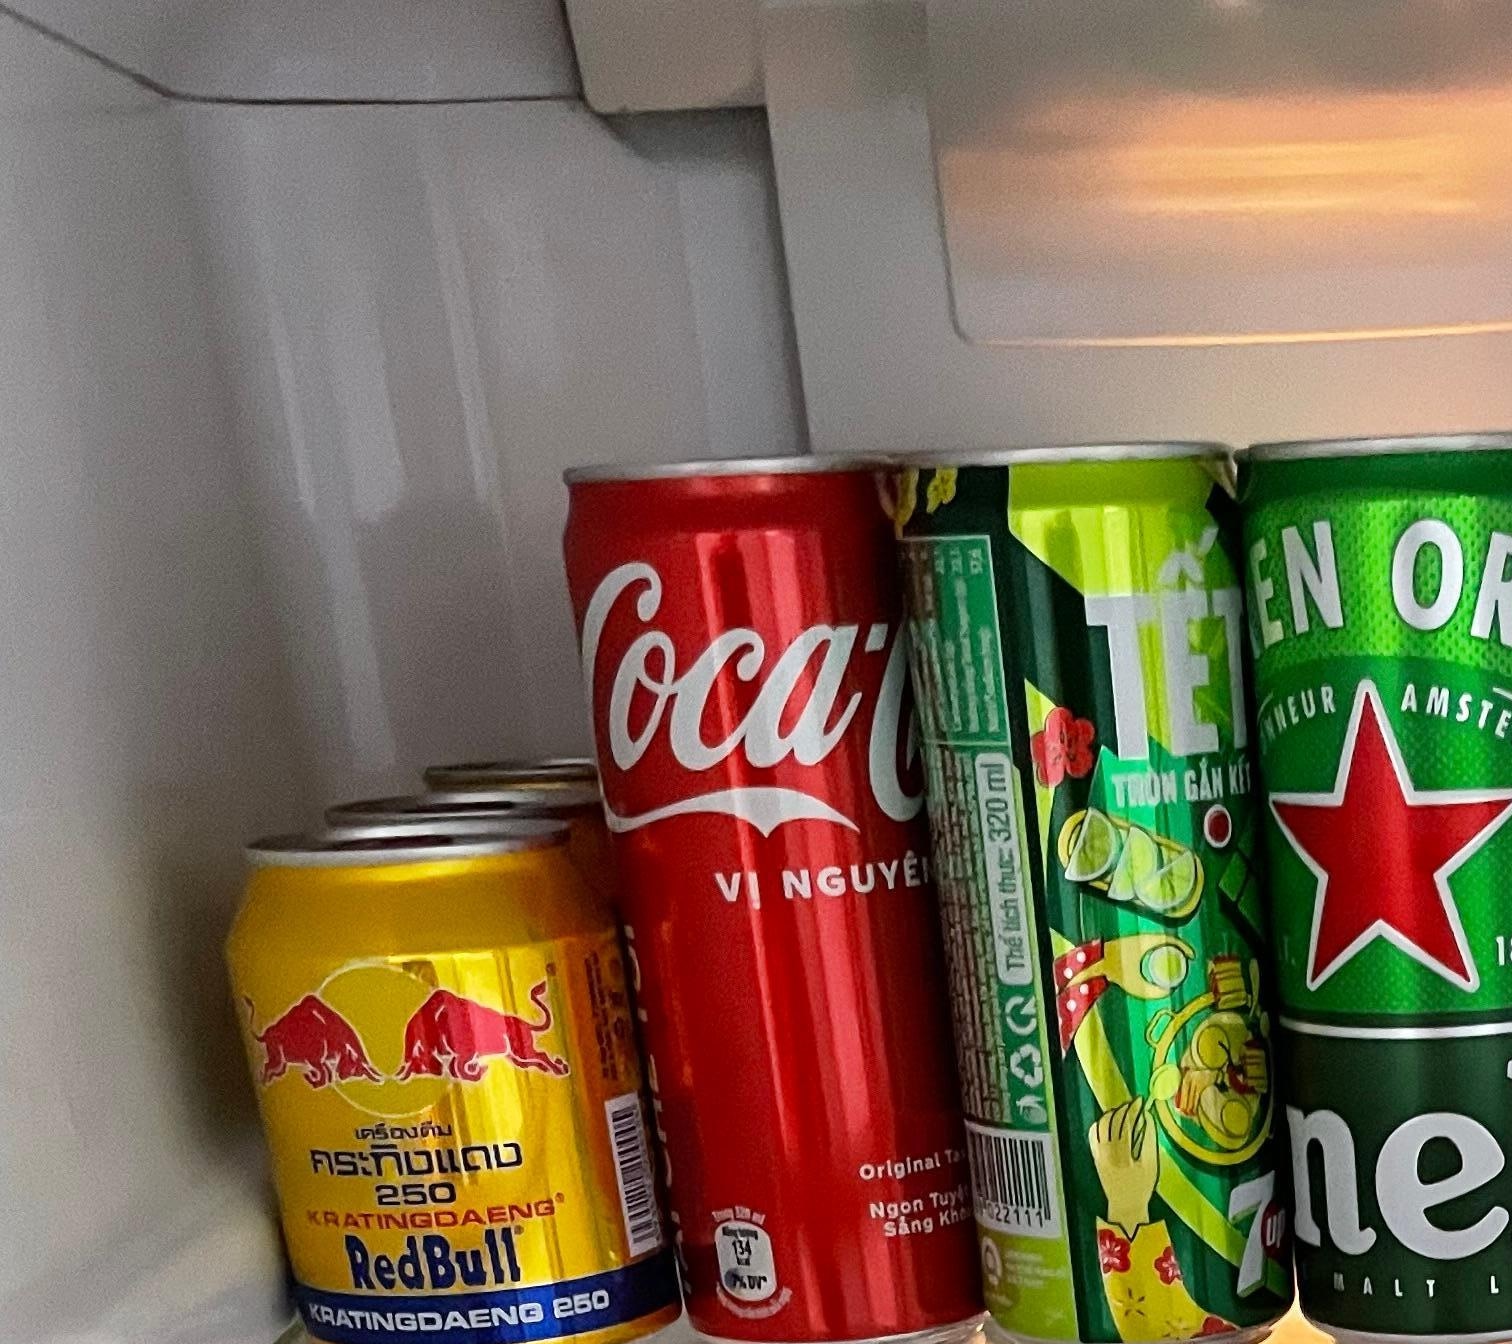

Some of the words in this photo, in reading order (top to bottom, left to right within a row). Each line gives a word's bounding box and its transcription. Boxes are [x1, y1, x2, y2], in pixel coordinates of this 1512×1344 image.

[980, 763, 1006, 792] ml
[986, 800, 1011, 842] 320
[859, 1153, 940, 1180] Original
[375, 1182, 457, 1206] 250
[870, 1199, 923, 1218] Ngon
[345, 1227, 521, 1290] RedBull
[1333, 1273, 1436, 1298] MALT
[308, 1302, 544, 1331] KRATINGDAENG
[552, 1289, 611, 1319] 250
